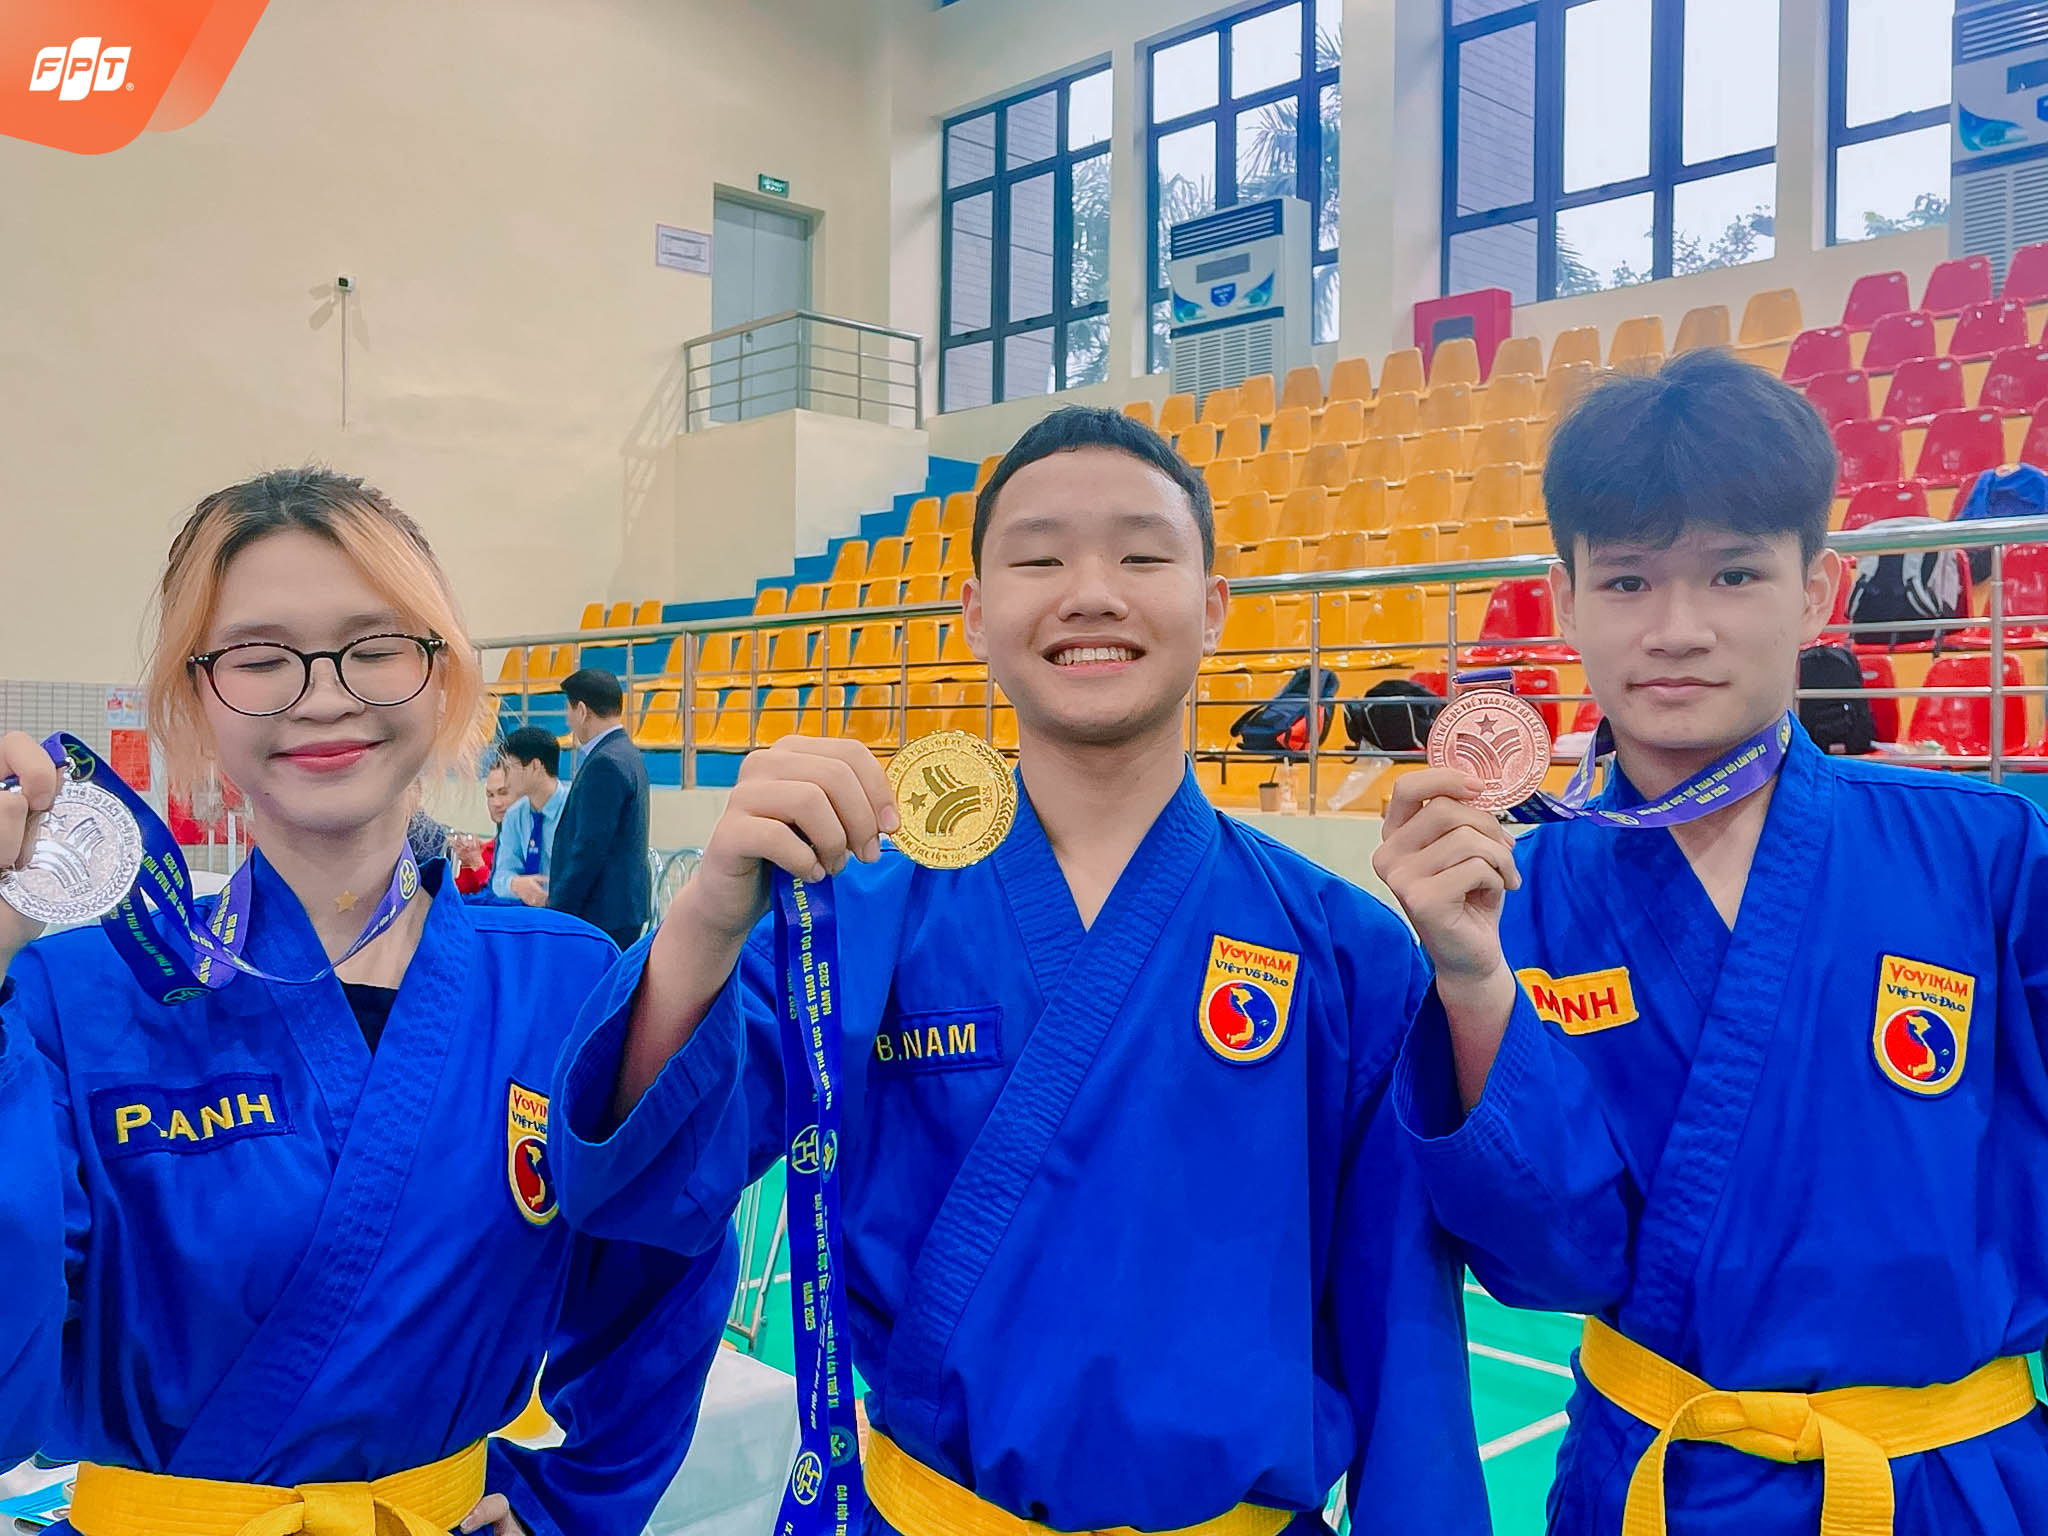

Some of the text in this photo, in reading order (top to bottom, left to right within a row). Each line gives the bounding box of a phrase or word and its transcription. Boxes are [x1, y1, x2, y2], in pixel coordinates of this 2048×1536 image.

[818, 961, 830, 987] 2025
[1219, 941, 1292, 974] VOVINAM
[805, 974, 816, 1003] THAO
[1889, 962, 1968, 998] VOVINAM
[876, 1023, 976, 1061] B.NAM
[115, 1094, 275, 1143] P.ANH
